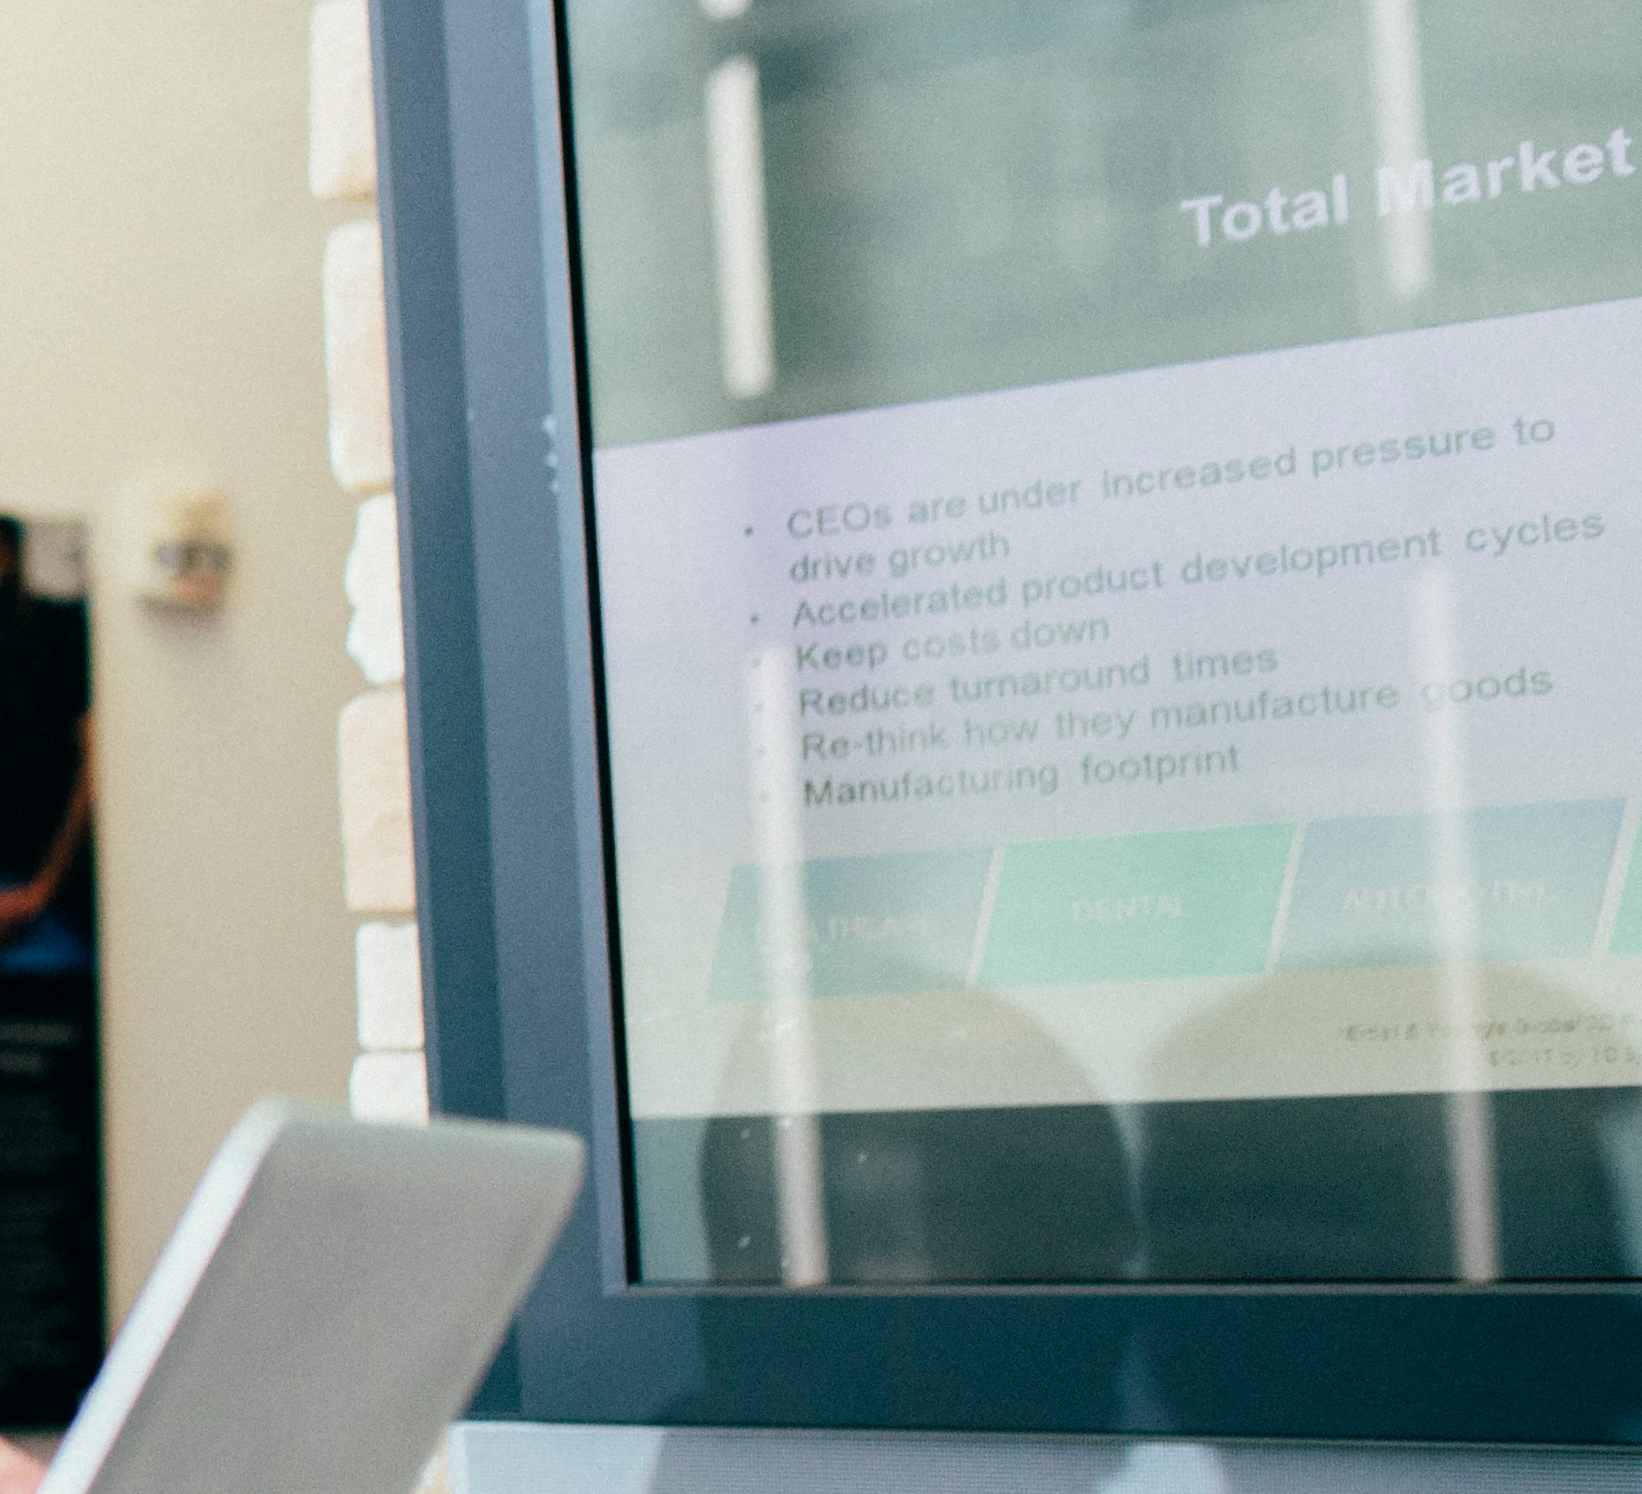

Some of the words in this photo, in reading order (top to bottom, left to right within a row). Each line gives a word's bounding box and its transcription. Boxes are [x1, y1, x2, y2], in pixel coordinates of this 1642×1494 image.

[1180, 173, 1349, 247] Total
[1377, 126, 1636, 217] Market
[786, 501, 891, 539] CEOs
[908, 495, 966, 524] are
[978, 479, 1083, 515] under
[1101, 445, 1297, 498] increased
[1312, 426, 1496, 478] pressure
[1513, 416, 1556, 446] to
[789, 551, 875, 584] drive
[888, 531, 1010, 577] growth
[793, 577, 1008, 628] Accelerated
[1021, 562, 1164, 606] product
[1180, 527, 1442, 584] development
[1464, 512, 1606, 557] cycles
[795, 640, 889, 673] Keep
[902, 626, 1002, 660] costs
[1010, 616, 1111, 648] down
[798, 681, 935, 717] Reduce
[950, 655, 1151, 703] turnaround
[1173, 646, 1279, 682] times
[801, 723, 950, 761] Re-think
[964, 717, 1040, 748] how
[1055, 707, 1135, 740] they
[1151, 684, 1401, 730] manufacture
[1420, 664, 1554, 714] goods
[802, 762, 1059, 808] Manufacturing
[1081, 744, 1239, 785] footprint
